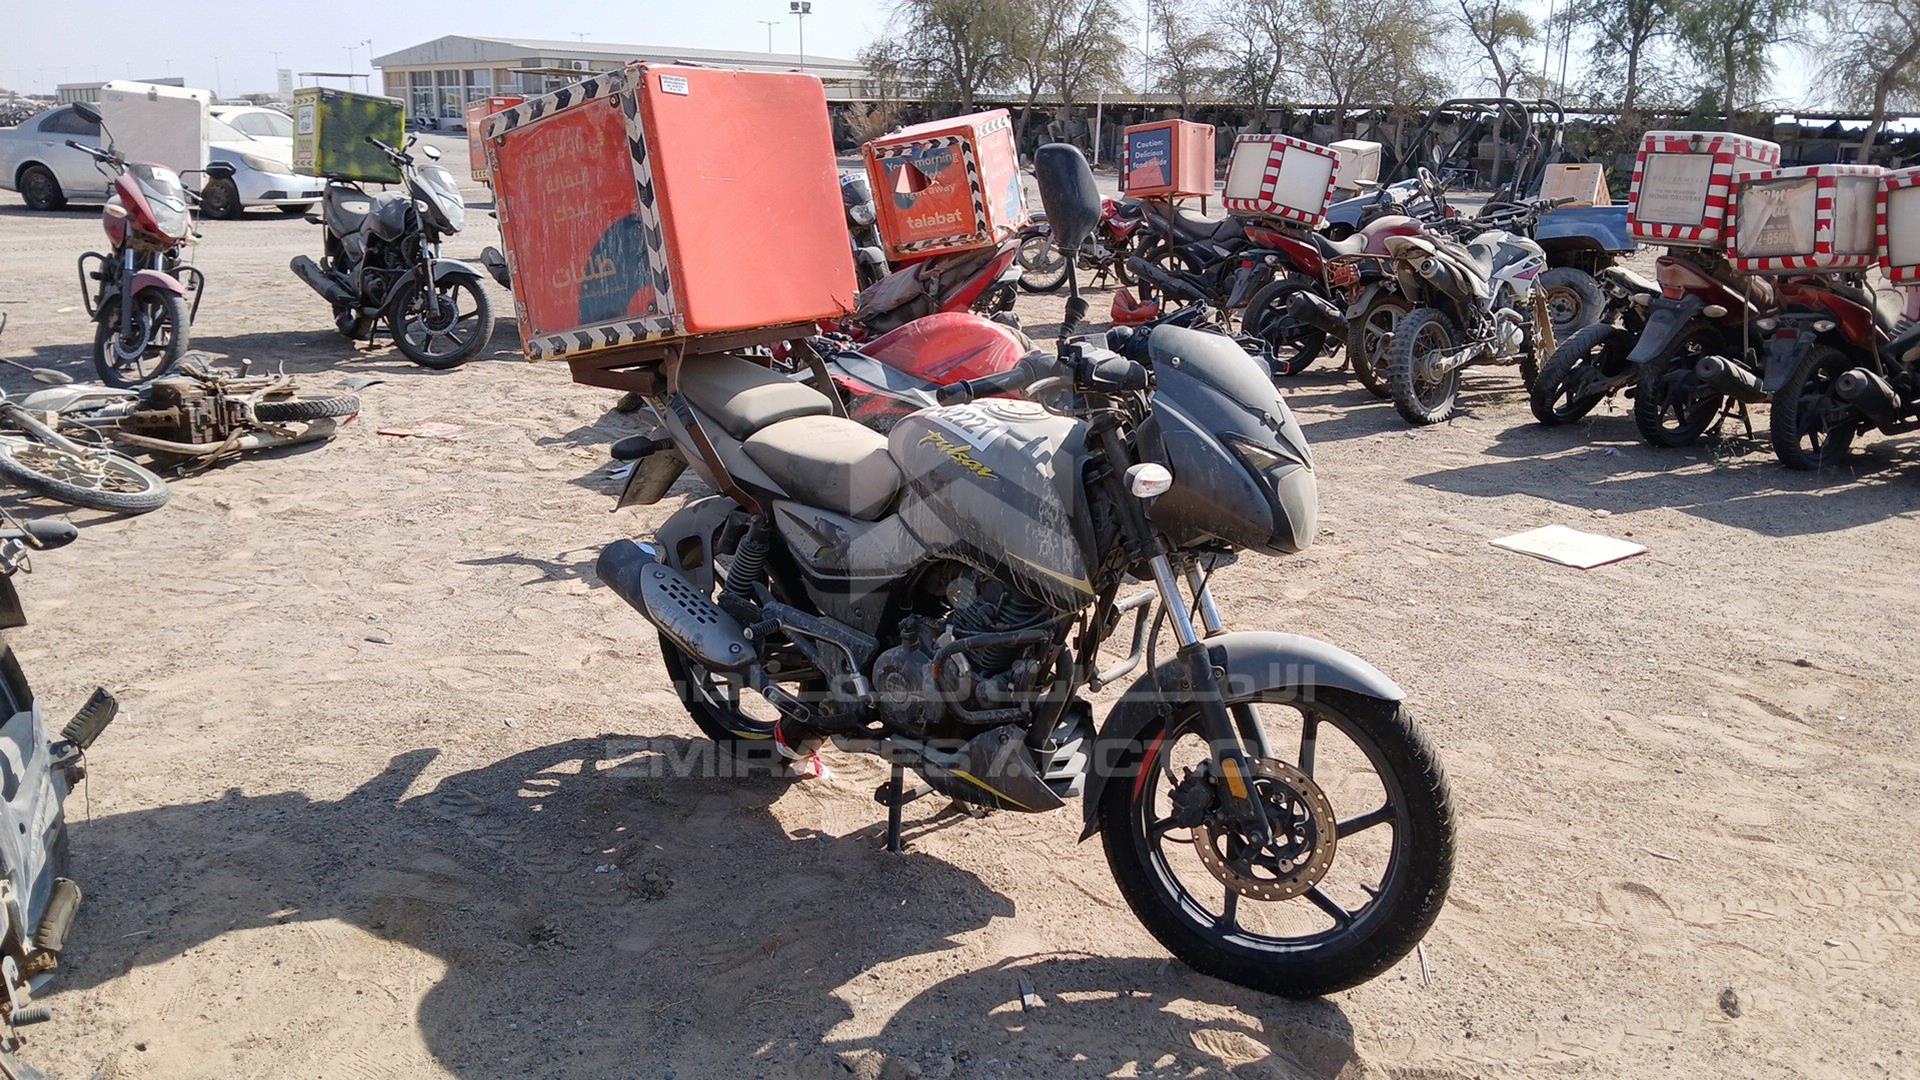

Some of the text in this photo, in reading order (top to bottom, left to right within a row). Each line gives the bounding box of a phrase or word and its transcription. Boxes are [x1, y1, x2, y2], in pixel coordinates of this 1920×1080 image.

[914, 152, 960, 167] morning
[1134, 149, 1164, 159] Delicious
[927, 183, 956, 196] away
[906, 208, 963, 229] talabat
[552, 254, 617, 289] طلبات
